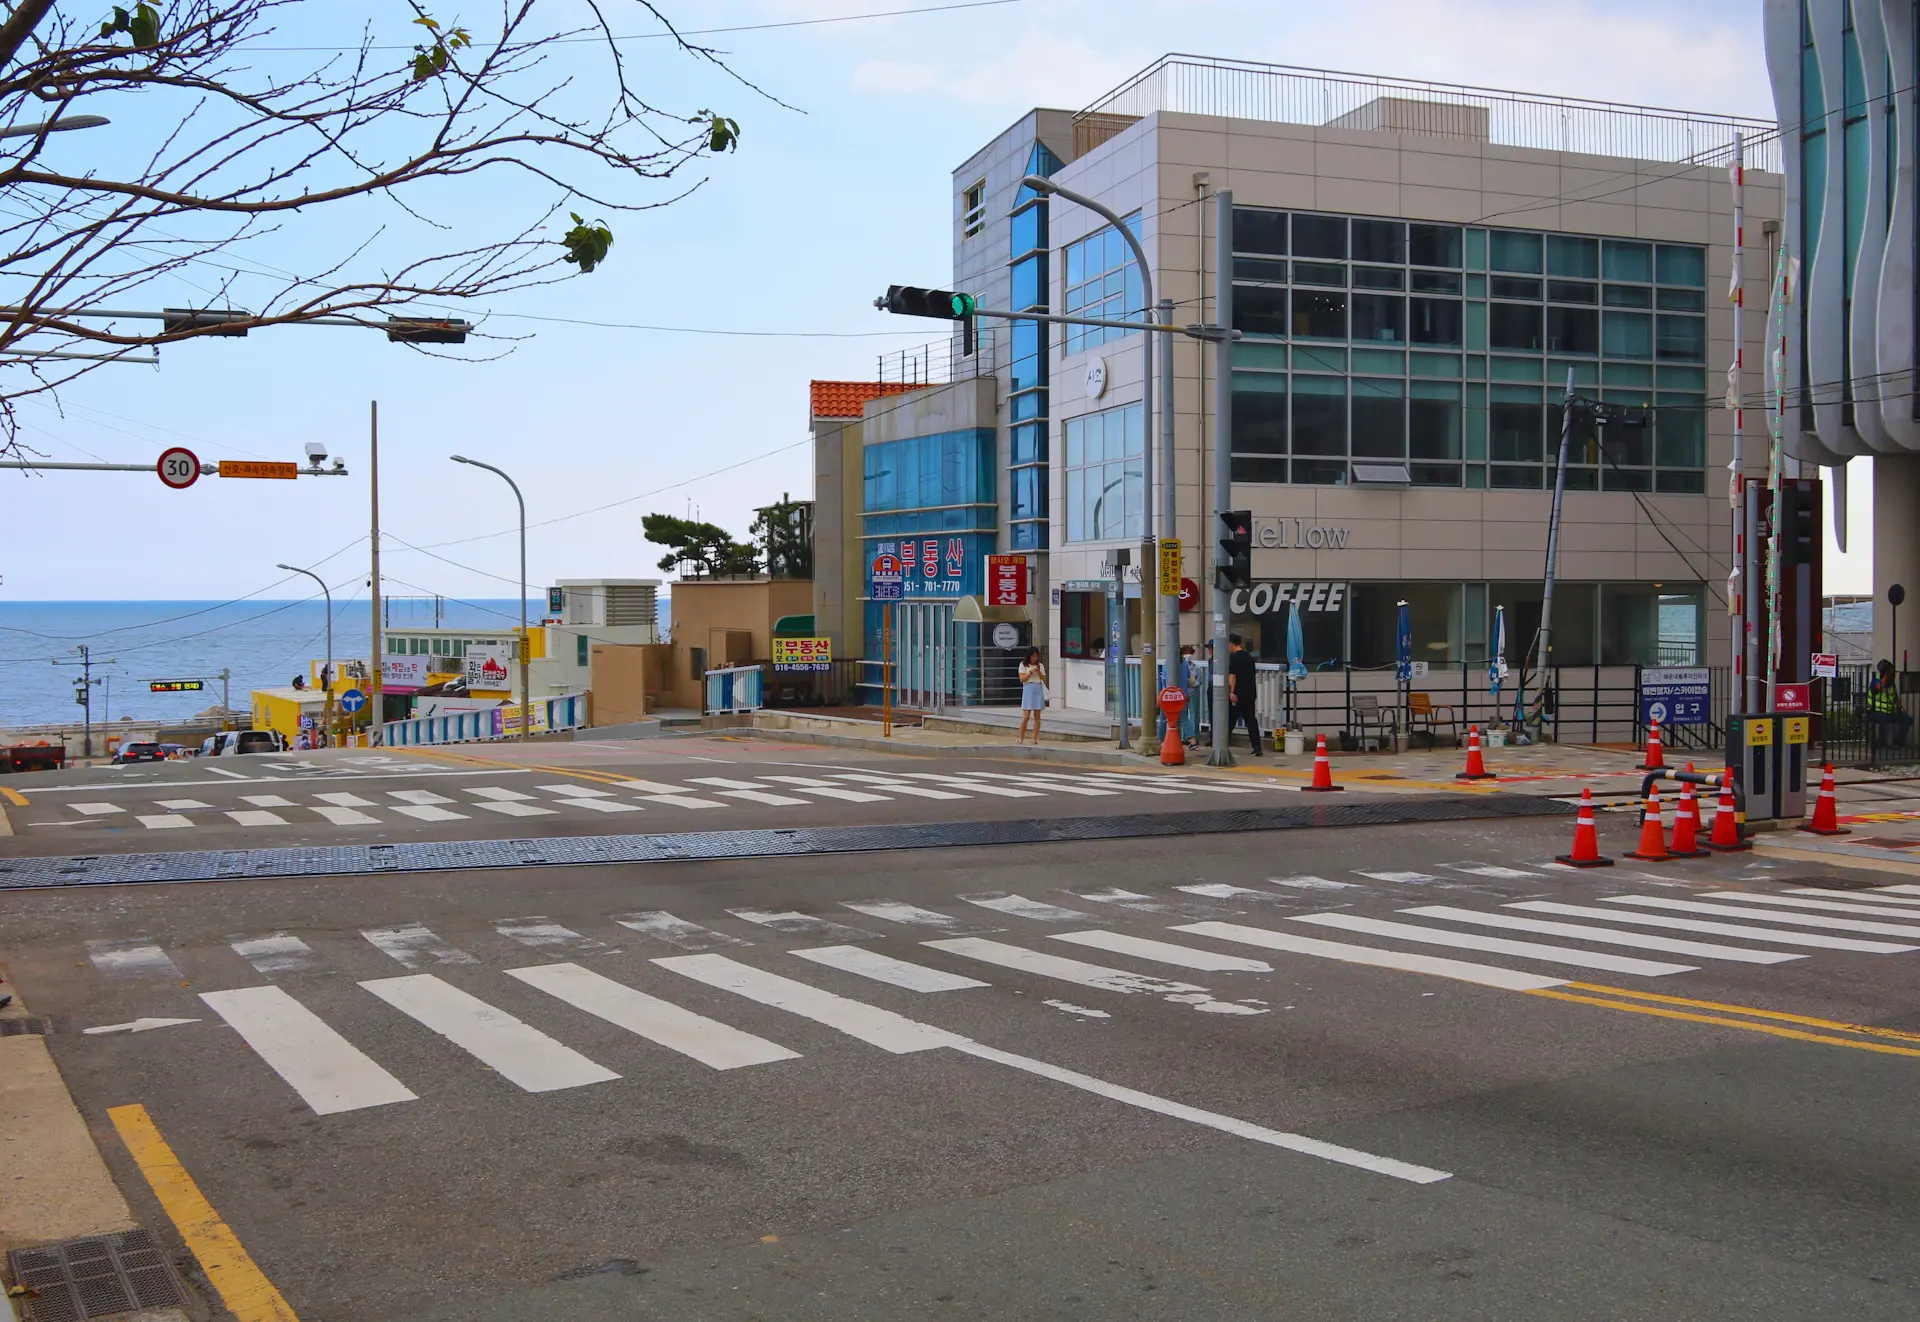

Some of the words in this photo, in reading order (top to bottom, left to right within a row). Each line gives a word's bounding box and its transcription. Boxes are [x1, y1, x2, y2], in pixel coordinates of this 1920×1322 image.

[167, 460, 190, 476] 30
[901, 540, 964, 577] 부동산
[997, 565, 1018, 604] 부동산
[1230, 583, 1347, 615] COFFEE
[785, 640, 829, 655] 부동산
